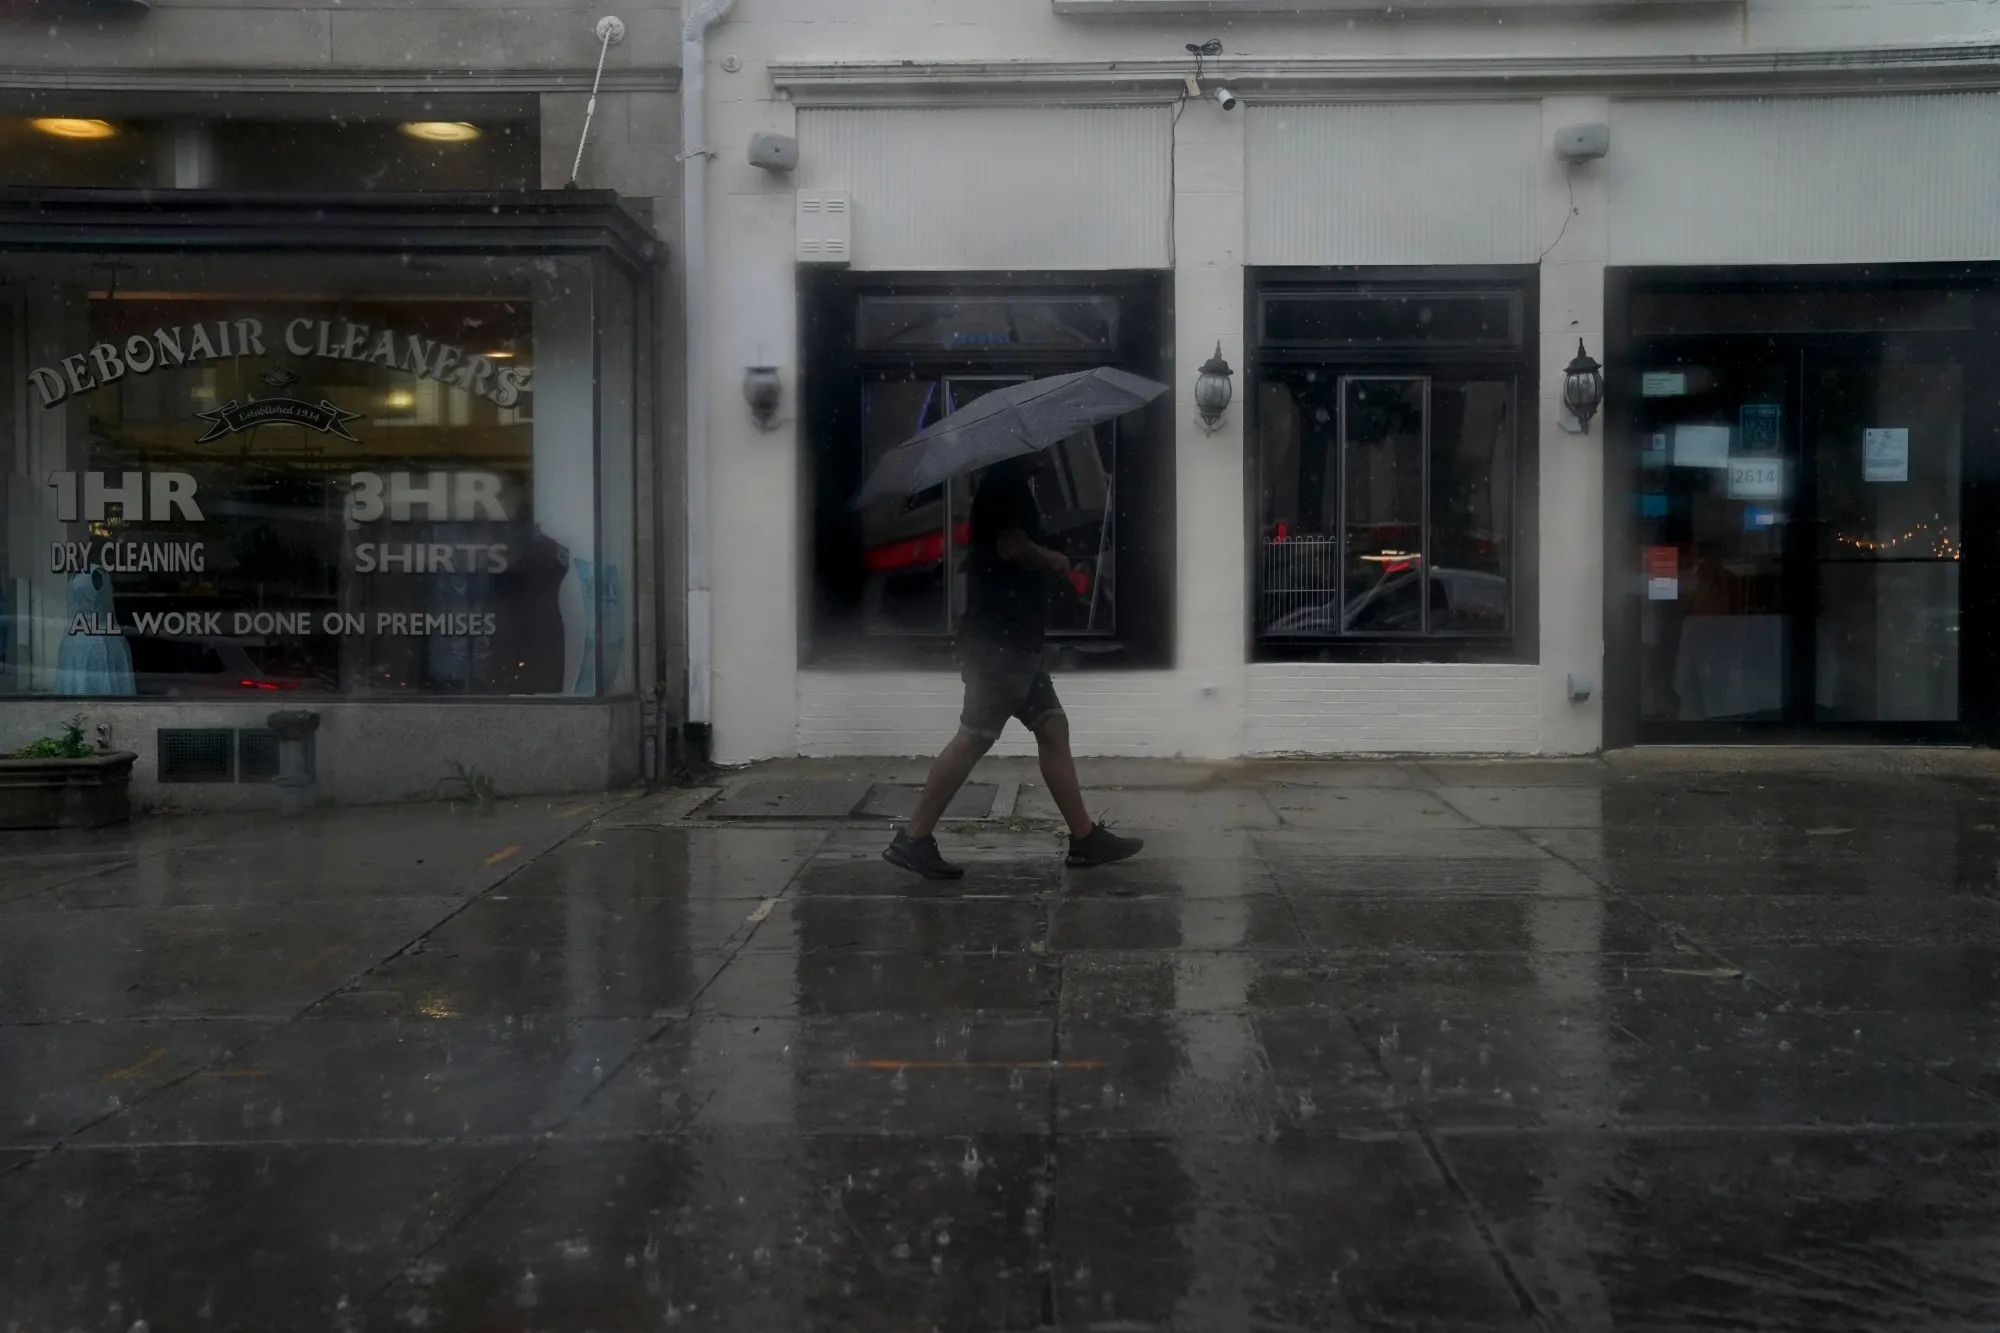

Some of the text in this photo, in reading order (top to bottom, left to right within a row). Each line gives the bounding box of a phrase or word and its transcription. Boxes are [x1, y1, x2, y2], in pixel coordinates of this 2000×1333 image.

[28, 317, 531, 408] DEBONAIR CLEANERS
[239, 403, 295, 421] Established
[1735, 469, 1774, 484] 2614
[48, 471, 206, 522] 1HR
[350, 471, 509, 522] 3HR
[51, 541, 205, 573] DRY CLEANING
[354, 543, 509, 574] SHIRTS
[69, 611, 497, 637] ALL WORK DONE ON PREMISES
